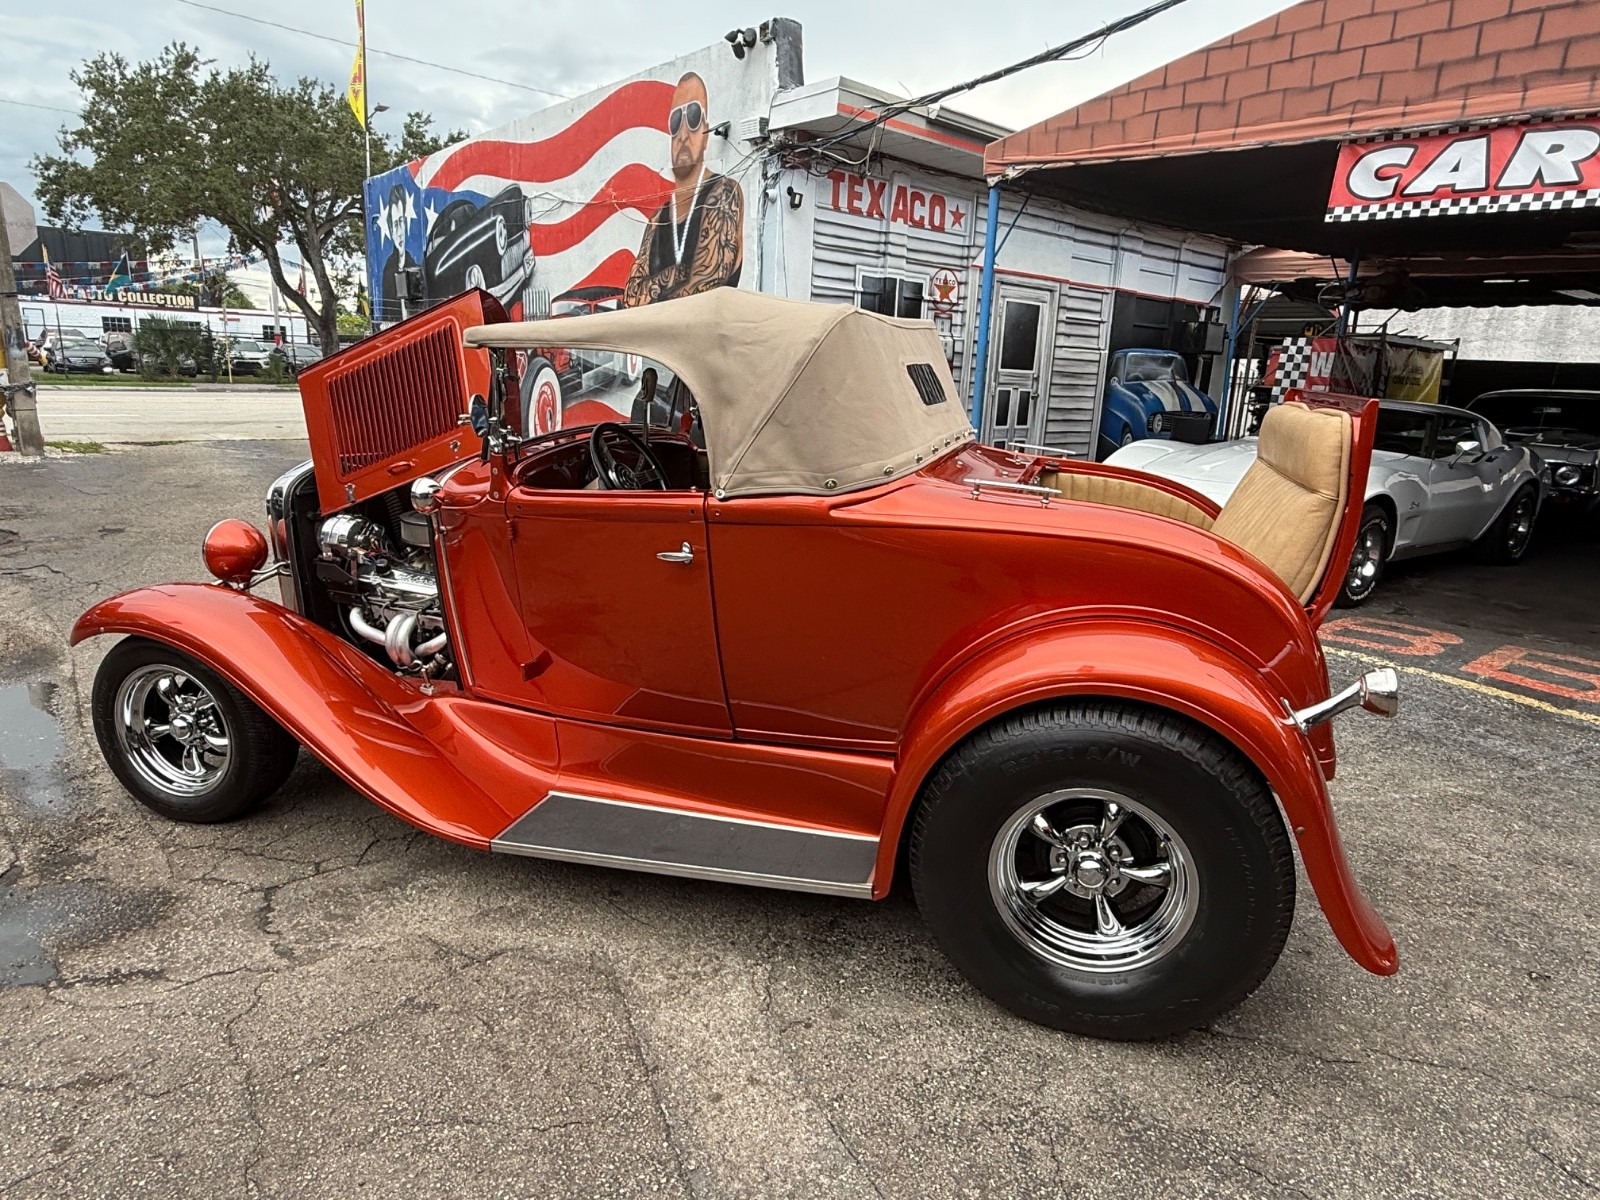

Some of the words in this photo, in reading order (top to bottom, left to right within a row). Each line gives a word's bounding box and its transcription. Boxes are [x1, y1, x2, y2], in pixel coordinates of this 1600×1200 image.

[1347, 127, 1600, 201] CAR
[826, 169, 946, 233] TEXACO
[118, 291, 194, 306] COLLECTION
